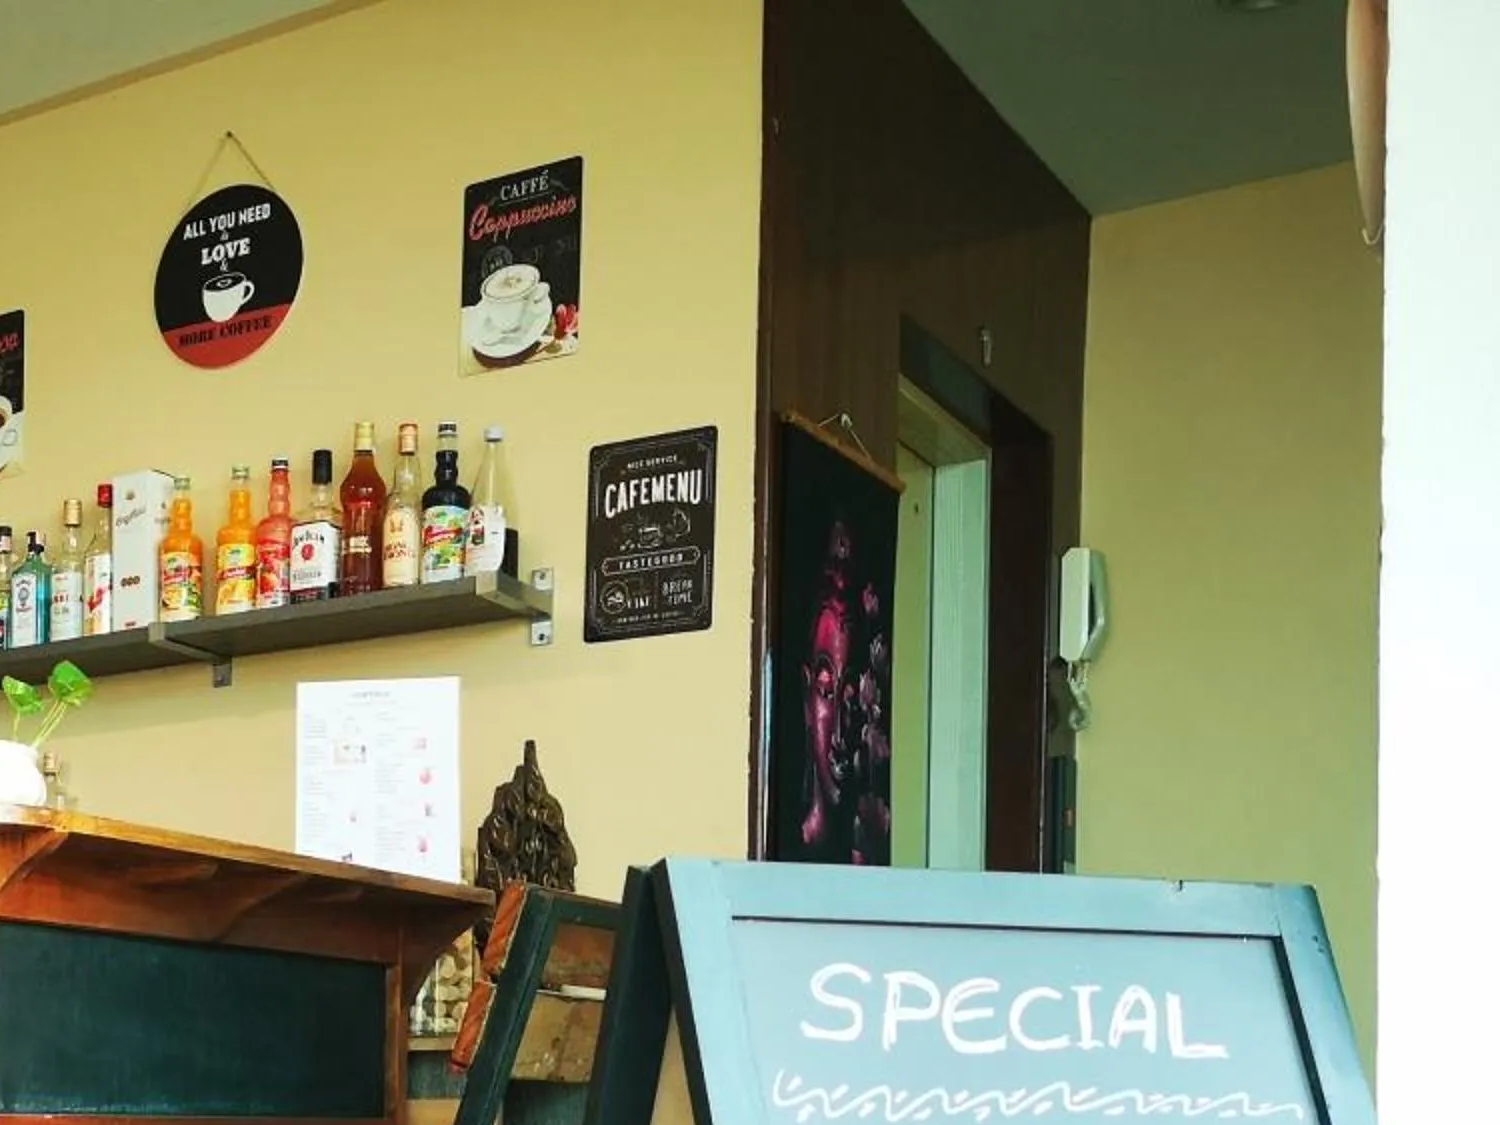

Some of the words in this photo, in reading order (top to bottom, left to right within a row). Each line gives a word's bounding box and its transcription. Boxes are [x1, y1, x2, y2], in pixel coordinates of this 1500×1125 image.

[183, 219, 207, 241] ALL
[209, 211, 236, 233] YOU
[238, 202, 271, 226] NEED
[469, 195, 577, 243] Cappuccino
[201, 237, 251, 265] LOVE
[219, 315, 273, 339] COFFEE
[605, 468, 702, 518] CAFEMENU
[800, 961, 1229, 1058] SPECIAL
